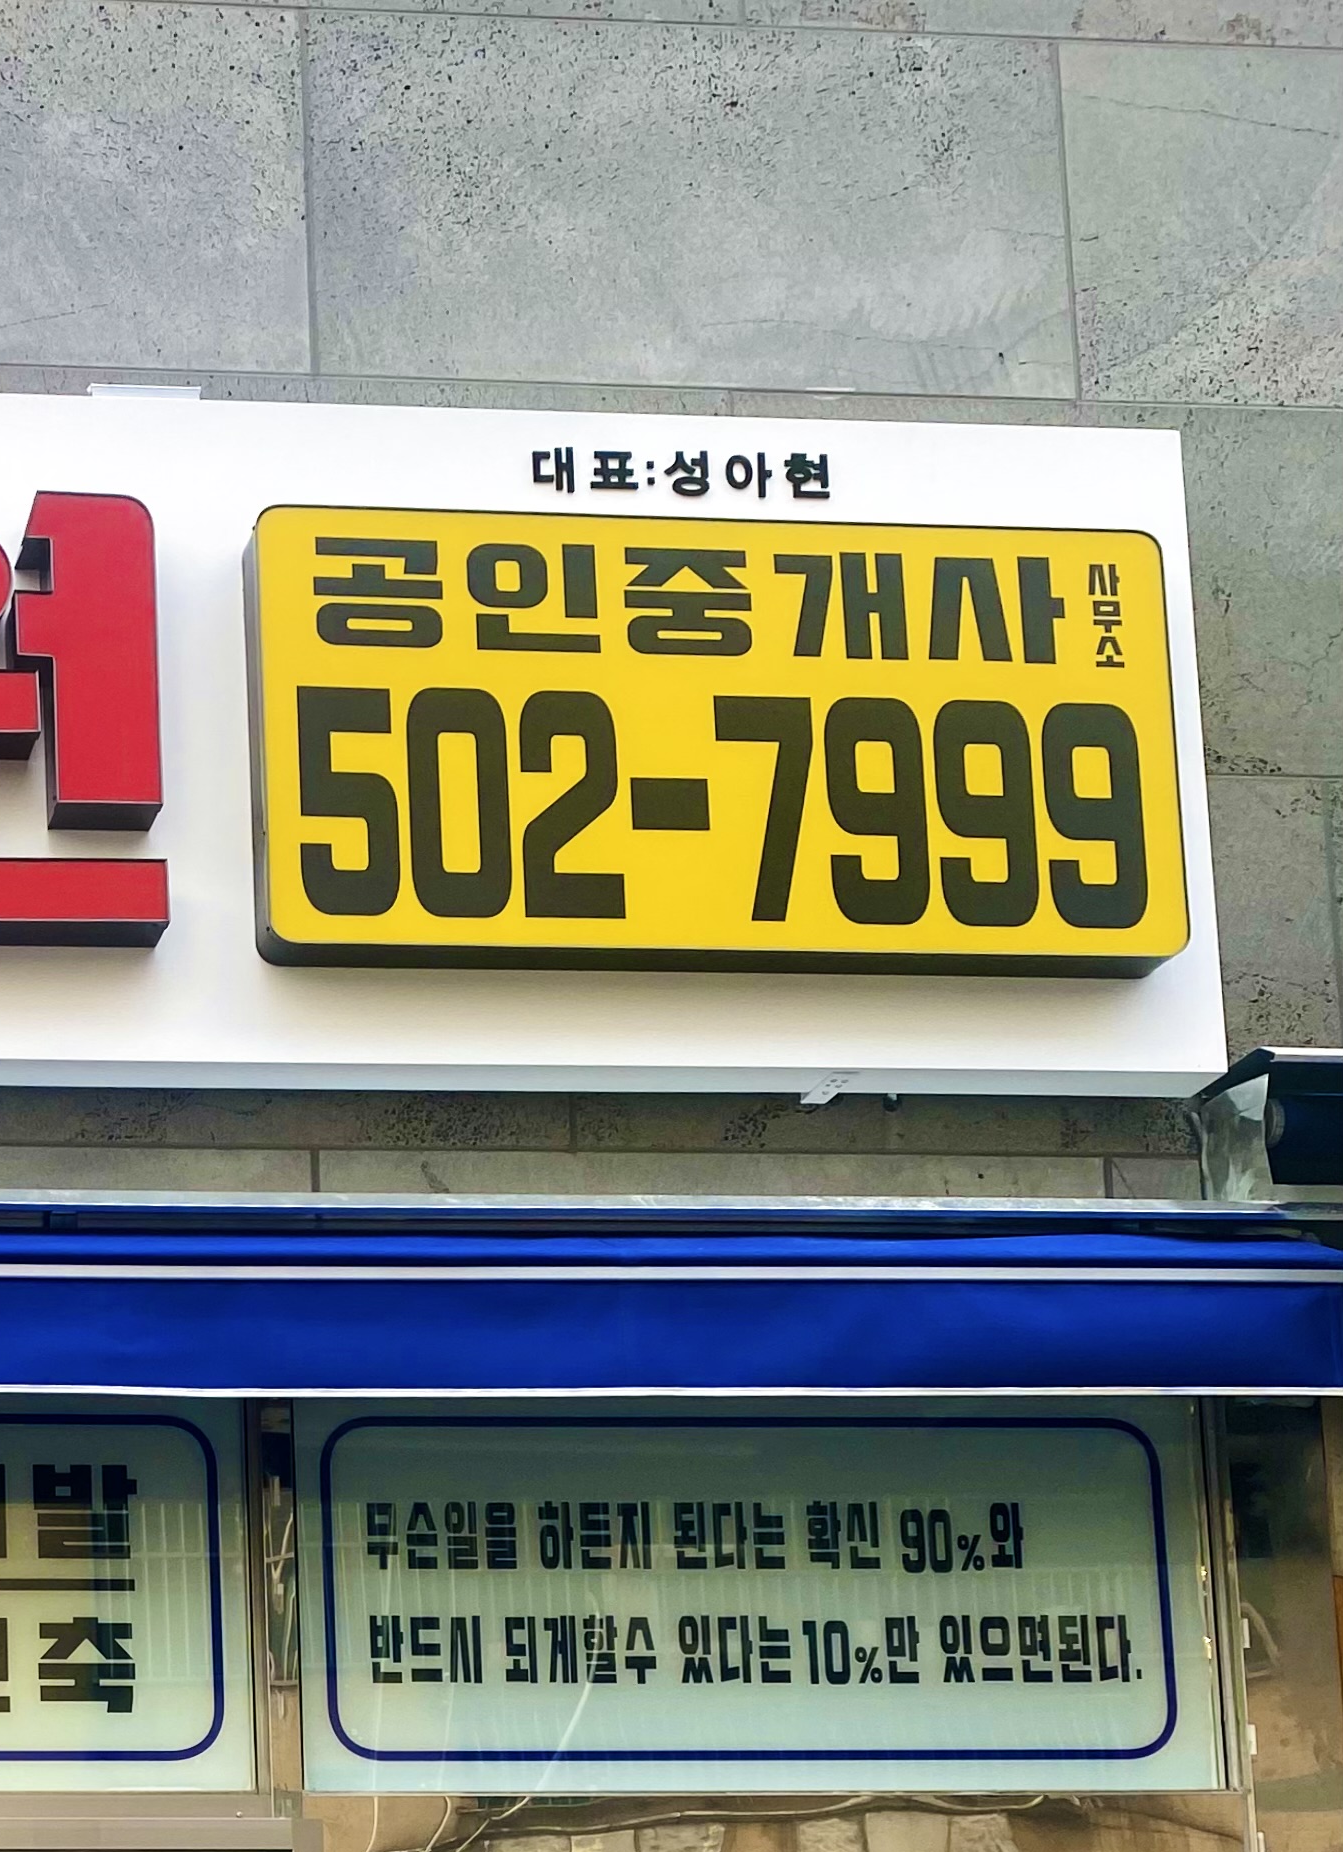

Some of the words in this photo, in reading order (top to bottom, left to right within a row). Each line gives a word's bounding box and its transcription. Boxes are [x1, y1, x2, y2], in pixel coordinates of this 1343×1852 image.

[531, 445, 833, 500] 대표:성아현
[312, 535, 1066, 666] 공인중개사
[294, 682, 1149, 930] 502-7999
[366, 1500, 518, 1571] 무슨일을
[538, 1499, 653, 1571] 하든지
[673, 1500, 787, 1571] 된다는
[806, 1499, 882, 1571] 확신
[899, 1501, 1025, 1574] 90%와
[368, 1614, 484, 1685] 반드시
